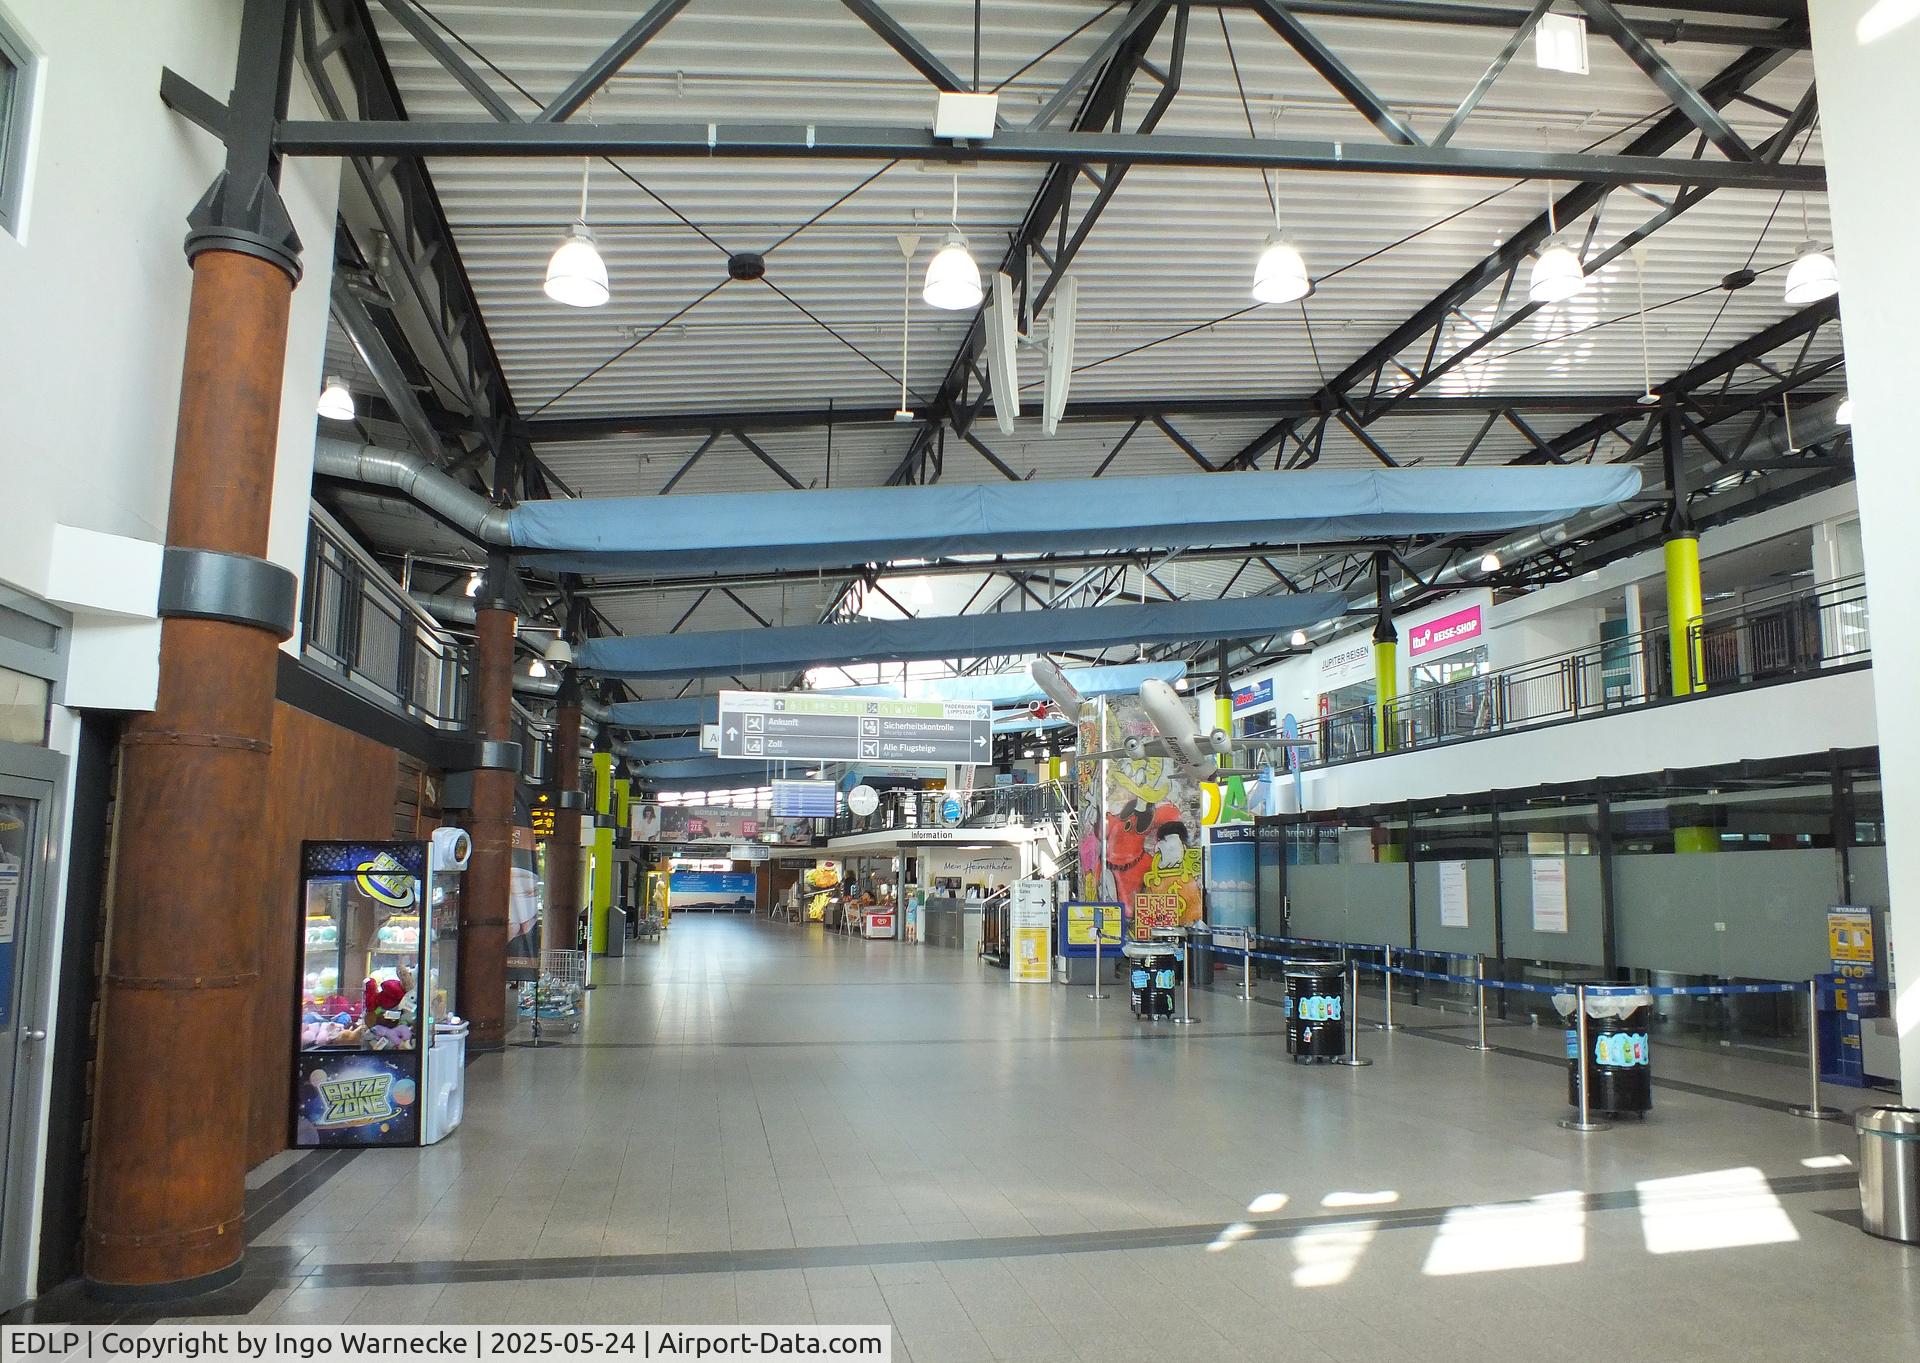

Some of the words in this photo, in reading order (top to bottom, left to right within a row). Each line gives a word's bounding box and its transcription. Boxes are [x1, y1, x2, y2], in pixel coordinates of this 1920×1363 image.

[1433, 620, 1478, 643] REISE-SHOP
[1321, 653, 1347, 670] JUPITER
[1346, 645, 1369, 661] REISEN
[768, 718, 799, 727] Ankunft
[884, 722, 955, 732] Sicherheitskontrolle
[768, 739, 782, 748] Zoll
[900, 744, 936, 754] Flugsteige
[911, 831, 953, 839] Information
[1243, 827, 1256, 838] Sie
[1259, 828, 1280, 838] doch
[943, 862, 961, 870] Mein
[322, 1077, 388, 1101] PRIZE
[327, 1096, 387, 1120] ZONE
